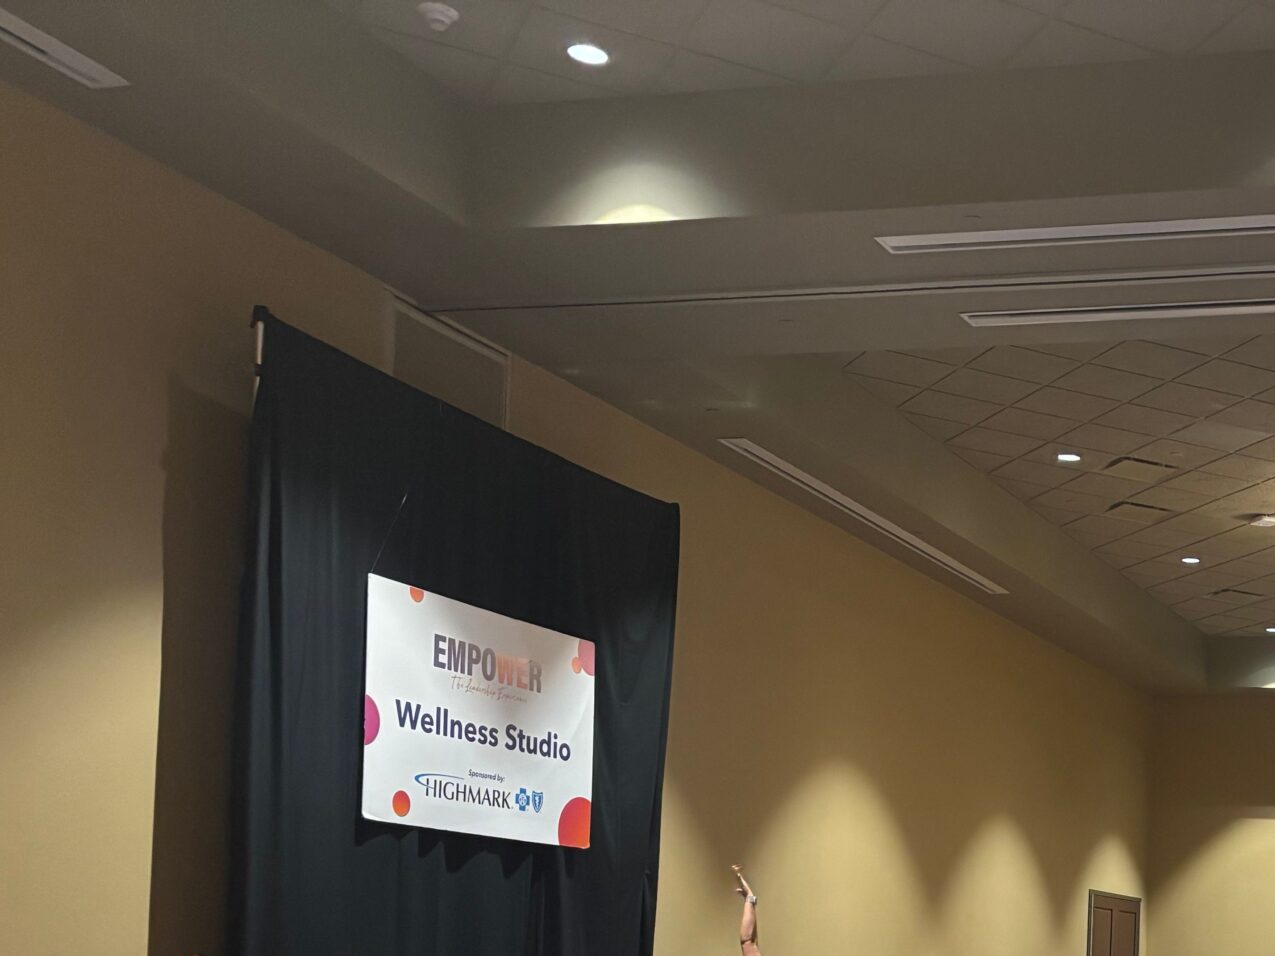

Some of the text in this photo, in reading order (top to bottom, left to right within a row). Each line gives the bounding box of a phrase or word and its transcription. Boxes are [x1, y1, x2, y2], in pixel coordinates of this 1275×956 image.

[433, 633, 542, 693] EMPOWER
[395, 699, 571, 761] Wellness Studio
[425, 778, 512, 809] HIGHMARK
[468, 769, 505, 783] Sponsored by:
